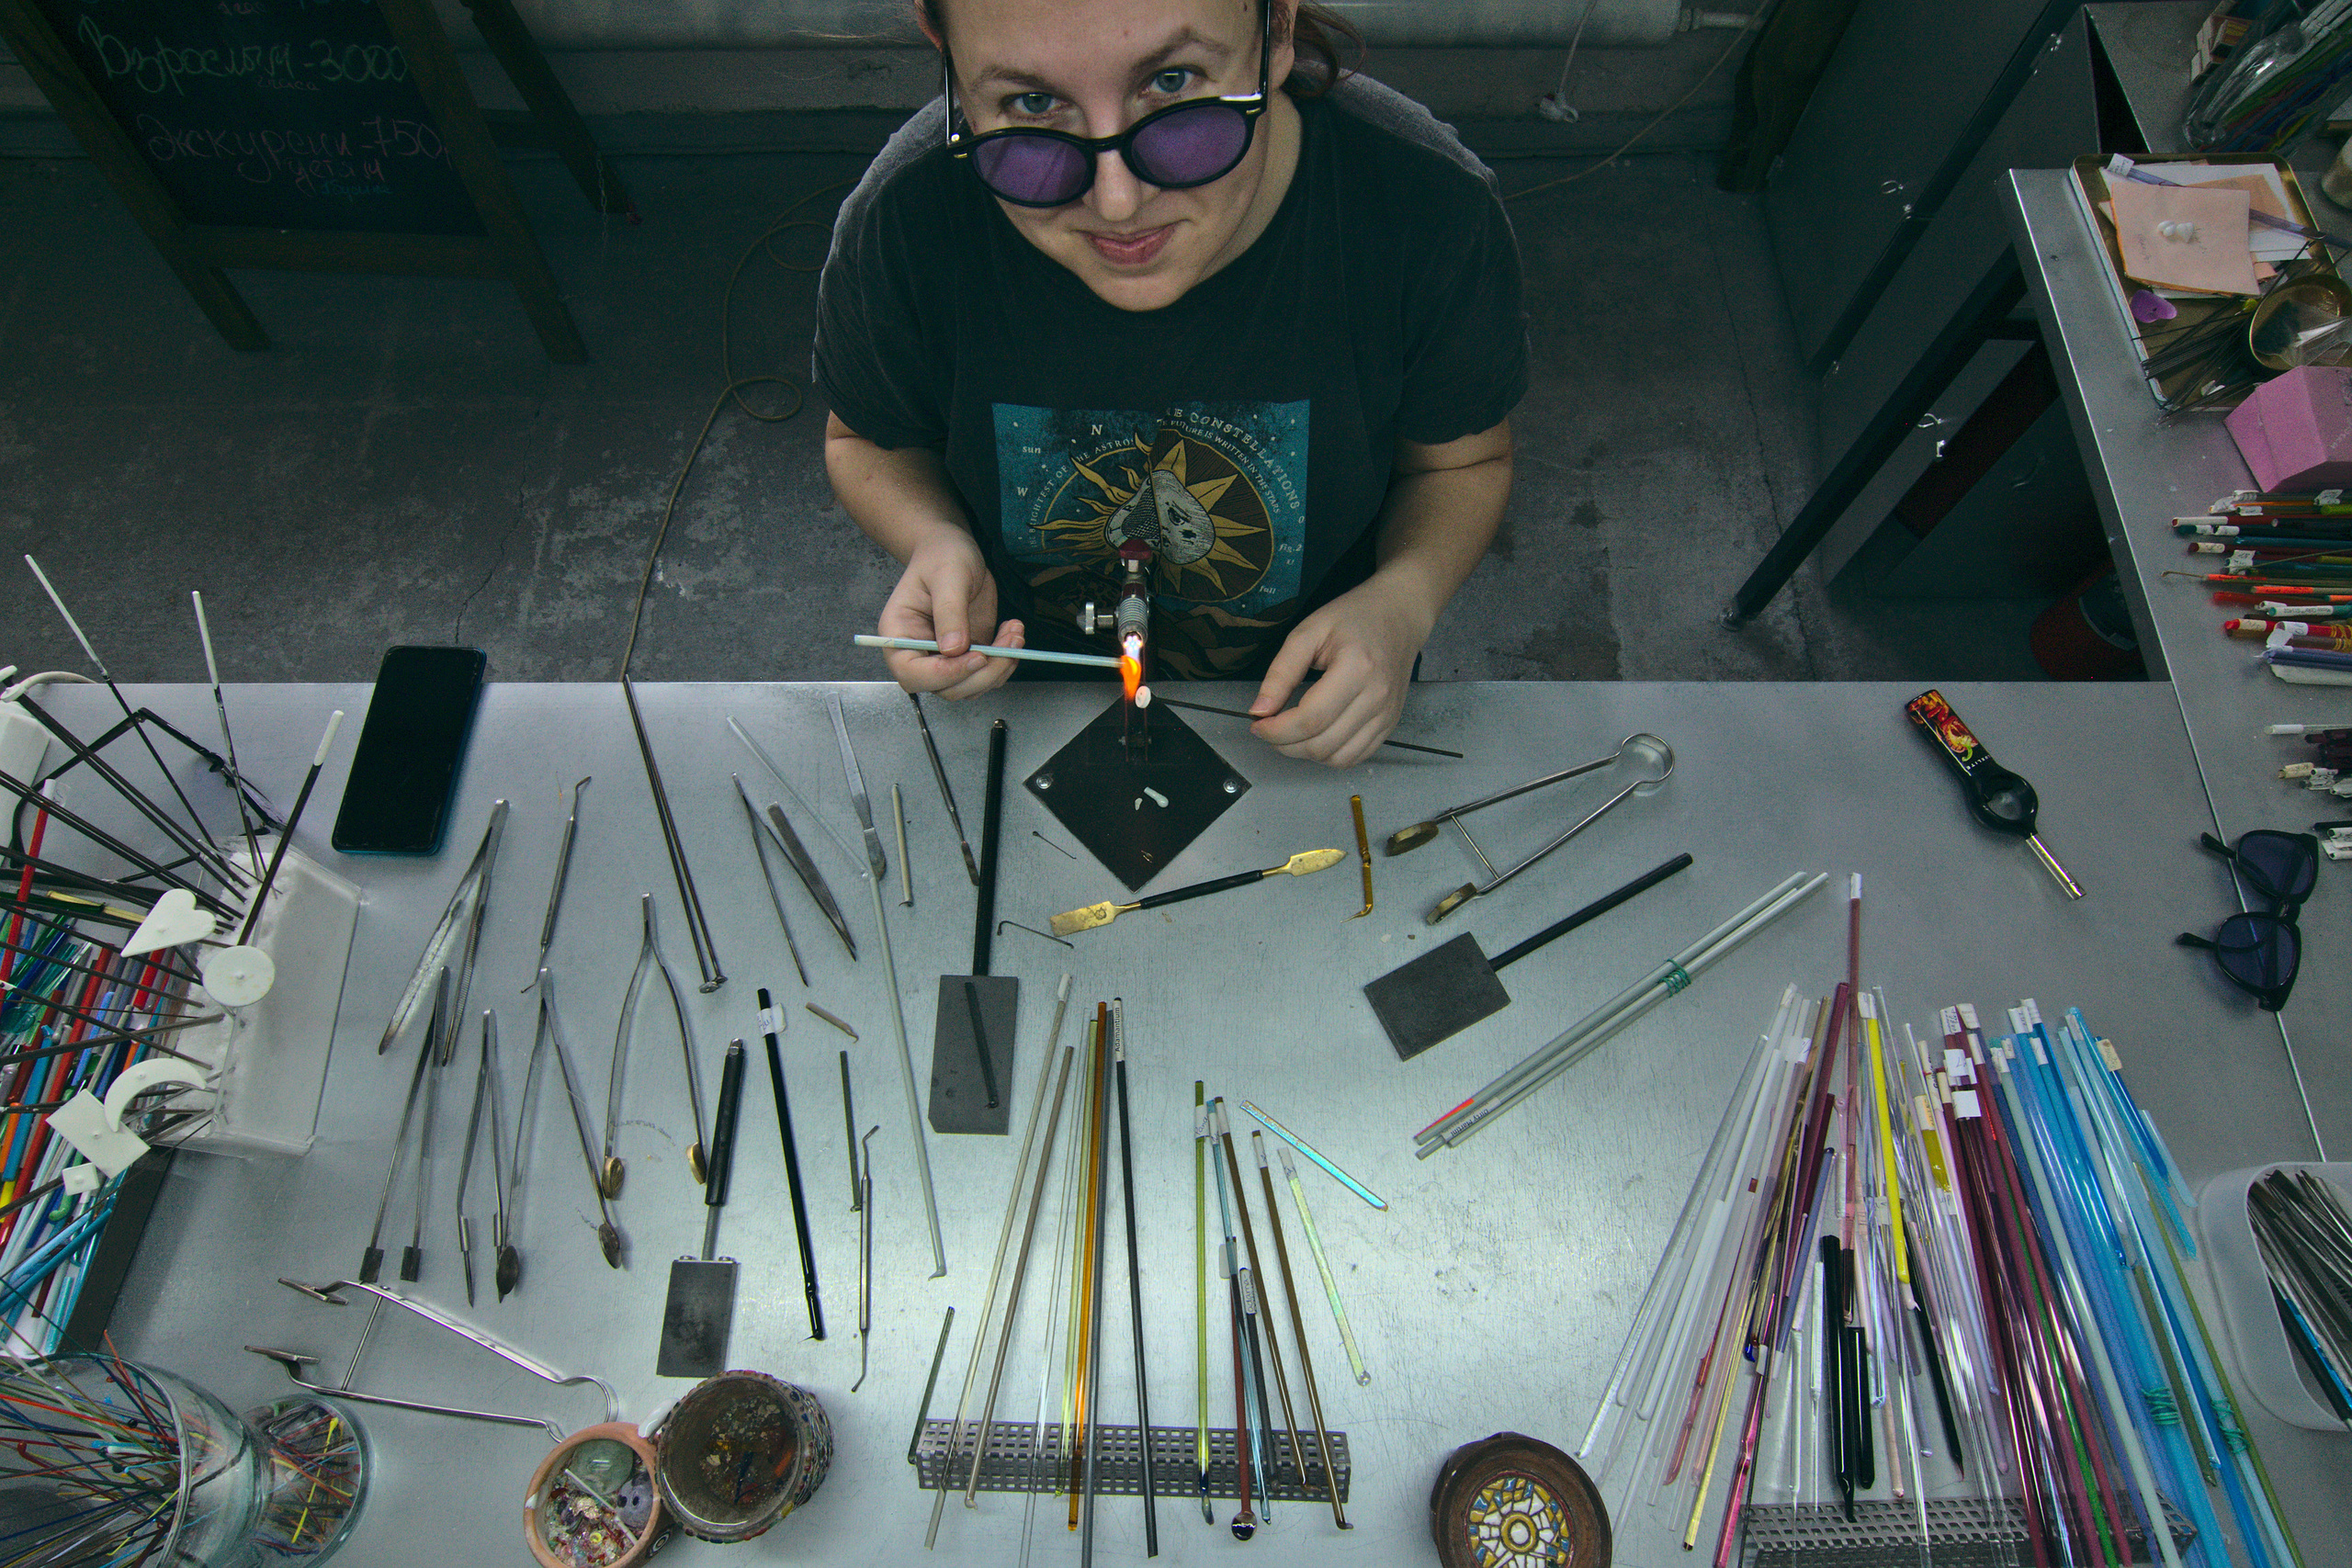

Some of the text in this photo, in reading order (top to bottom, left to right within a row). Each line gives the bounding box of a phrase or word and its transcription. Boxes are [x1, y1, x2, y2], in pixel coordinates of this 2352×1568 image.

[1091, 423, 1103, 435] N
[1022, 445, 1042, 454] sun
[1055, 464, 1069, 479] OF
[1094, 437, 1134, 455] ASTRO
[1170, 420, 1203, 436] FUTURE
[1204, 431, 1213, 439] IS
[1215, 435, 1250, 464] WRITTEN
[1248, 463, 1258, 474] IN
[1255, 473, 1269, 490] THE
[1265, 490, 1280, 513] STARS
[1189, 412, 1300, 510] CONSTELLATIONS
[1017, 487, 1029, 497] W
[1259, 585, 1276, 594] fall
[1450, 1108, 1489, 1137] Dirty Martini
